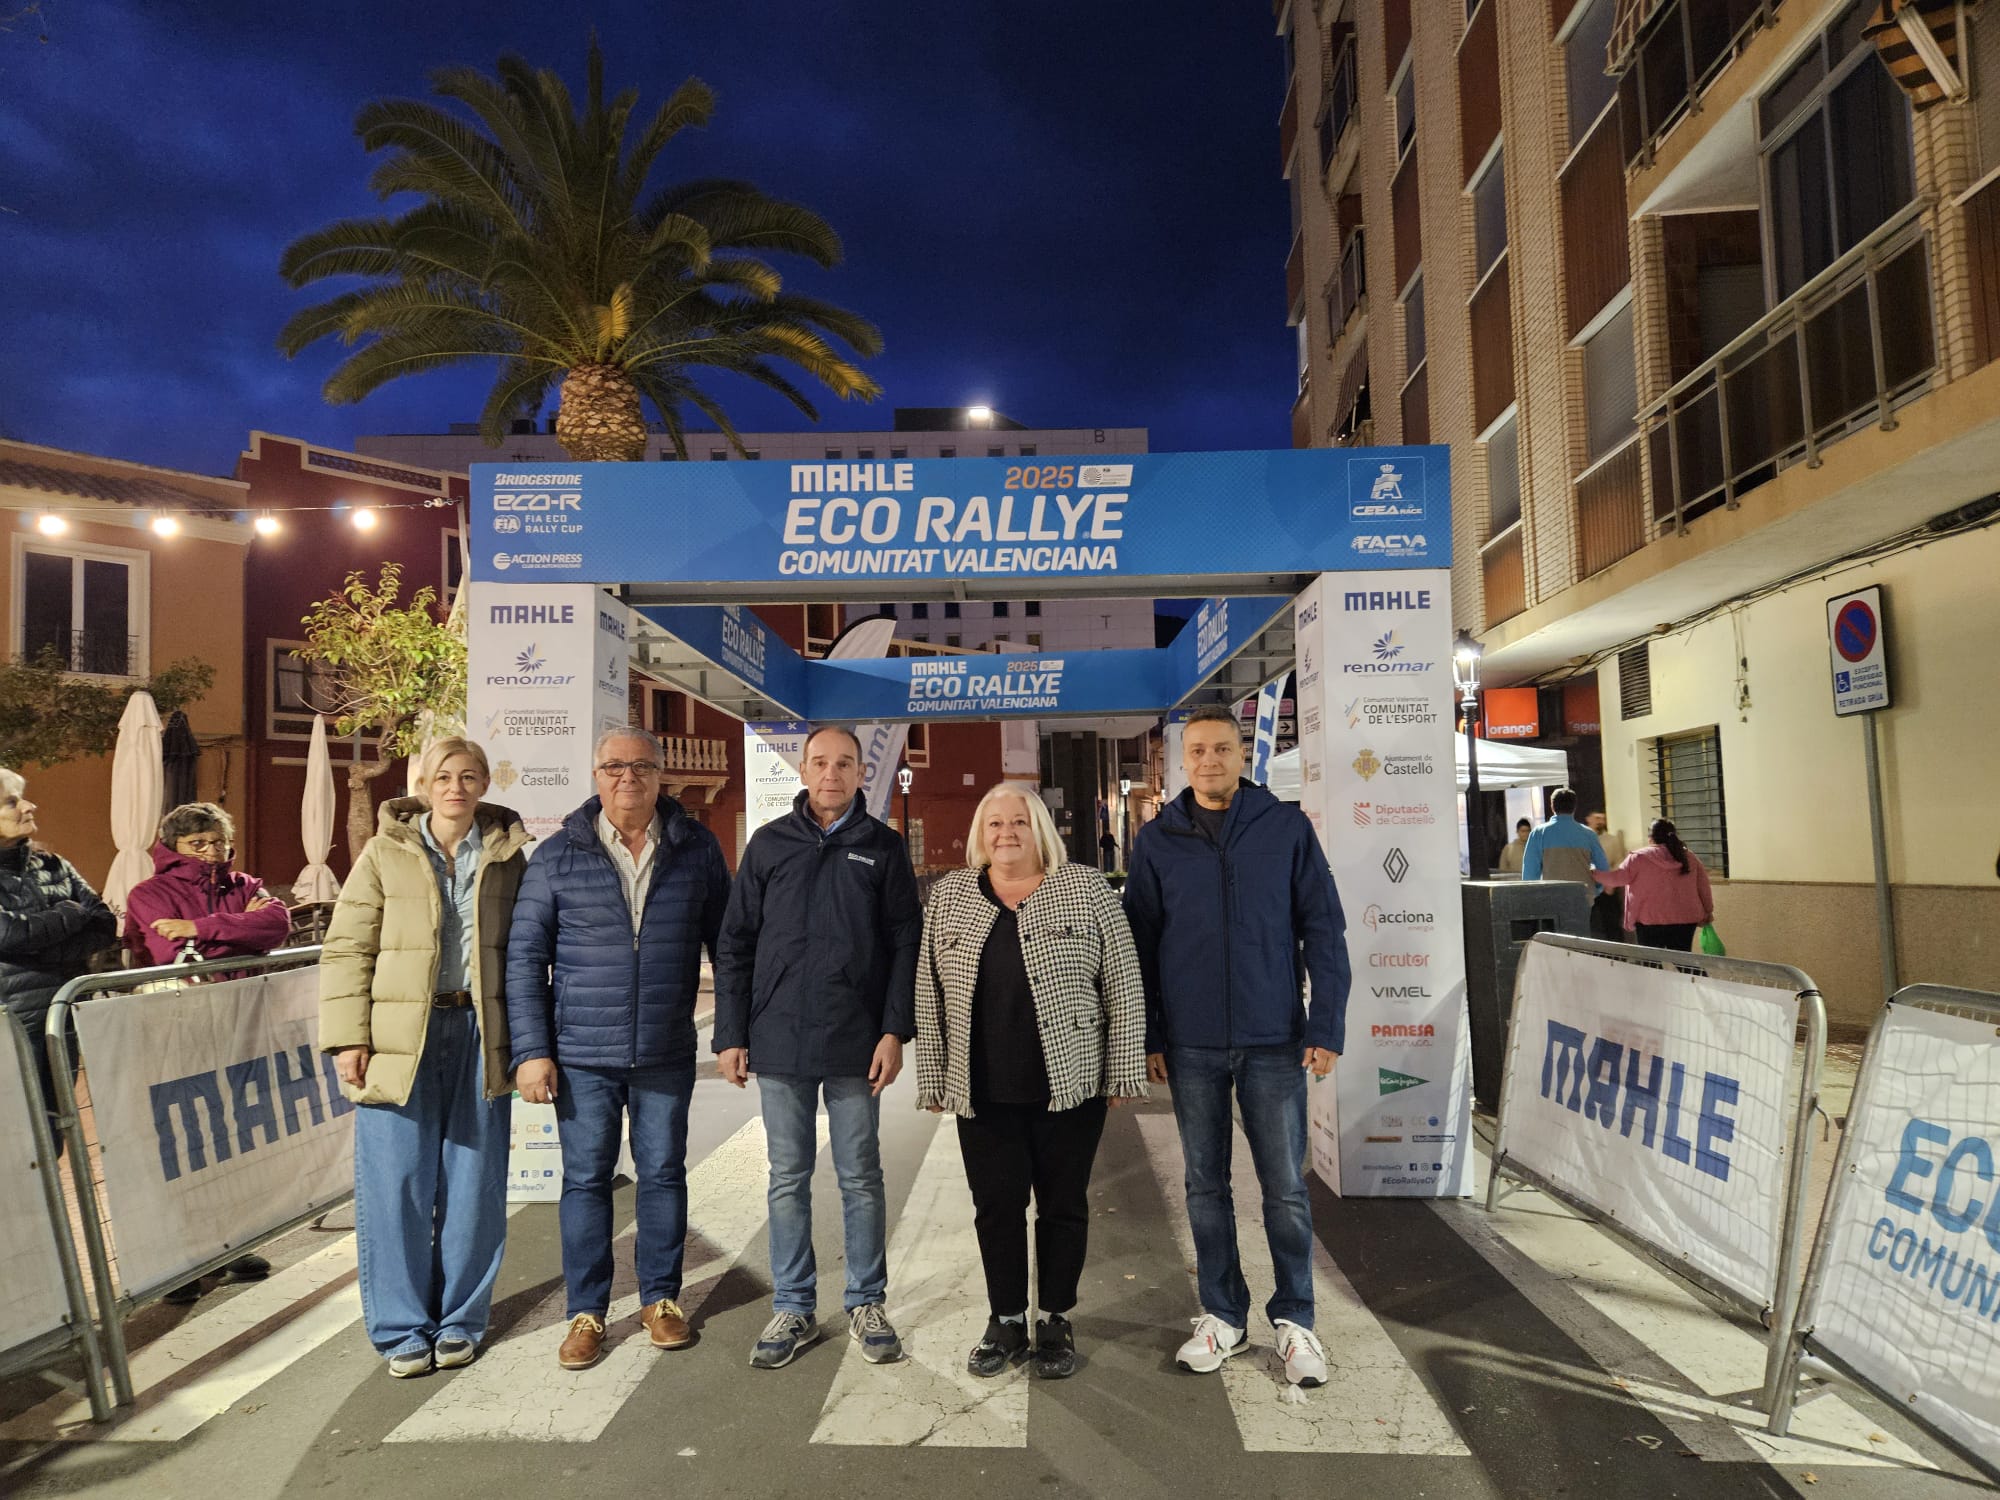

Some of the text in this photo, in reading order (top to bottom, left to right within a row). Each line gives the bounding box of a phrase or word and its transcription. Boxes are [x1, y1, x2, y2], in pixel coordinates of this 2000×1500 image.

[494, 473, 583, 486] BRIDGESTONE
[790, 463, 914, 492] MAHLE
[1004, 466, 1074, 490] 2025
[525, 514, 567, 523] FIA ECO
[783, 493, 1129, 545] ECO RALLYE
[525, 524, 583, 534] RALLY CUP
[511, 553, 583, 564] ACTION PRESS
[778, 546, 1118, 575] COMUNITAT VALENCIANA
[1344, 590, 1431, 611] MAHLE
[490, 605, 574, 624] MAHLE
[600, 610, 625, 641] MAHLE
[722, 614, 739, 651] ECO
[911, 661, 967, 676] MAHLE
[1007, 661, 1038, 673] 2025
[1343, 662, 1435, 673] renomar
[487, 675, 576, 685] renomar
[909, 673, 1062, 699] ECO RALLYE
[907, 696, 1058, 713] COMUNITAT VALENCIANA
[1363, 703, 1429, 714] COMUNITAT
[504, 716, 568, 726] COMUNITAT
[1368, 713, 1438, 725] DE L'ESPORT
[508, 726, 577, 736] DE L'ESPORT
[756, 743, 798, 753] MAHLE
[1424, 753, 1433, 762] de
[1383, 762, 1434, 776] Castelló
[521, 774, 570, 786] Castelló
[1375, 803, 1430, 815] Diputació
[1376, 815, 1435, 826] de Castelló
[1378, 910, 1434, 924] acciona
[1369, 952, 1430, 968] Circutor
[1371, 986, 1431, 998] VIMEL
[1371, 1024, 1435, 1038] PAMESA
[1540, 1019, 1740, 1182] MAHLE
[149, 1044, 356, 1182] MAHL
[1885, 1118, 2000, 1254] EC
